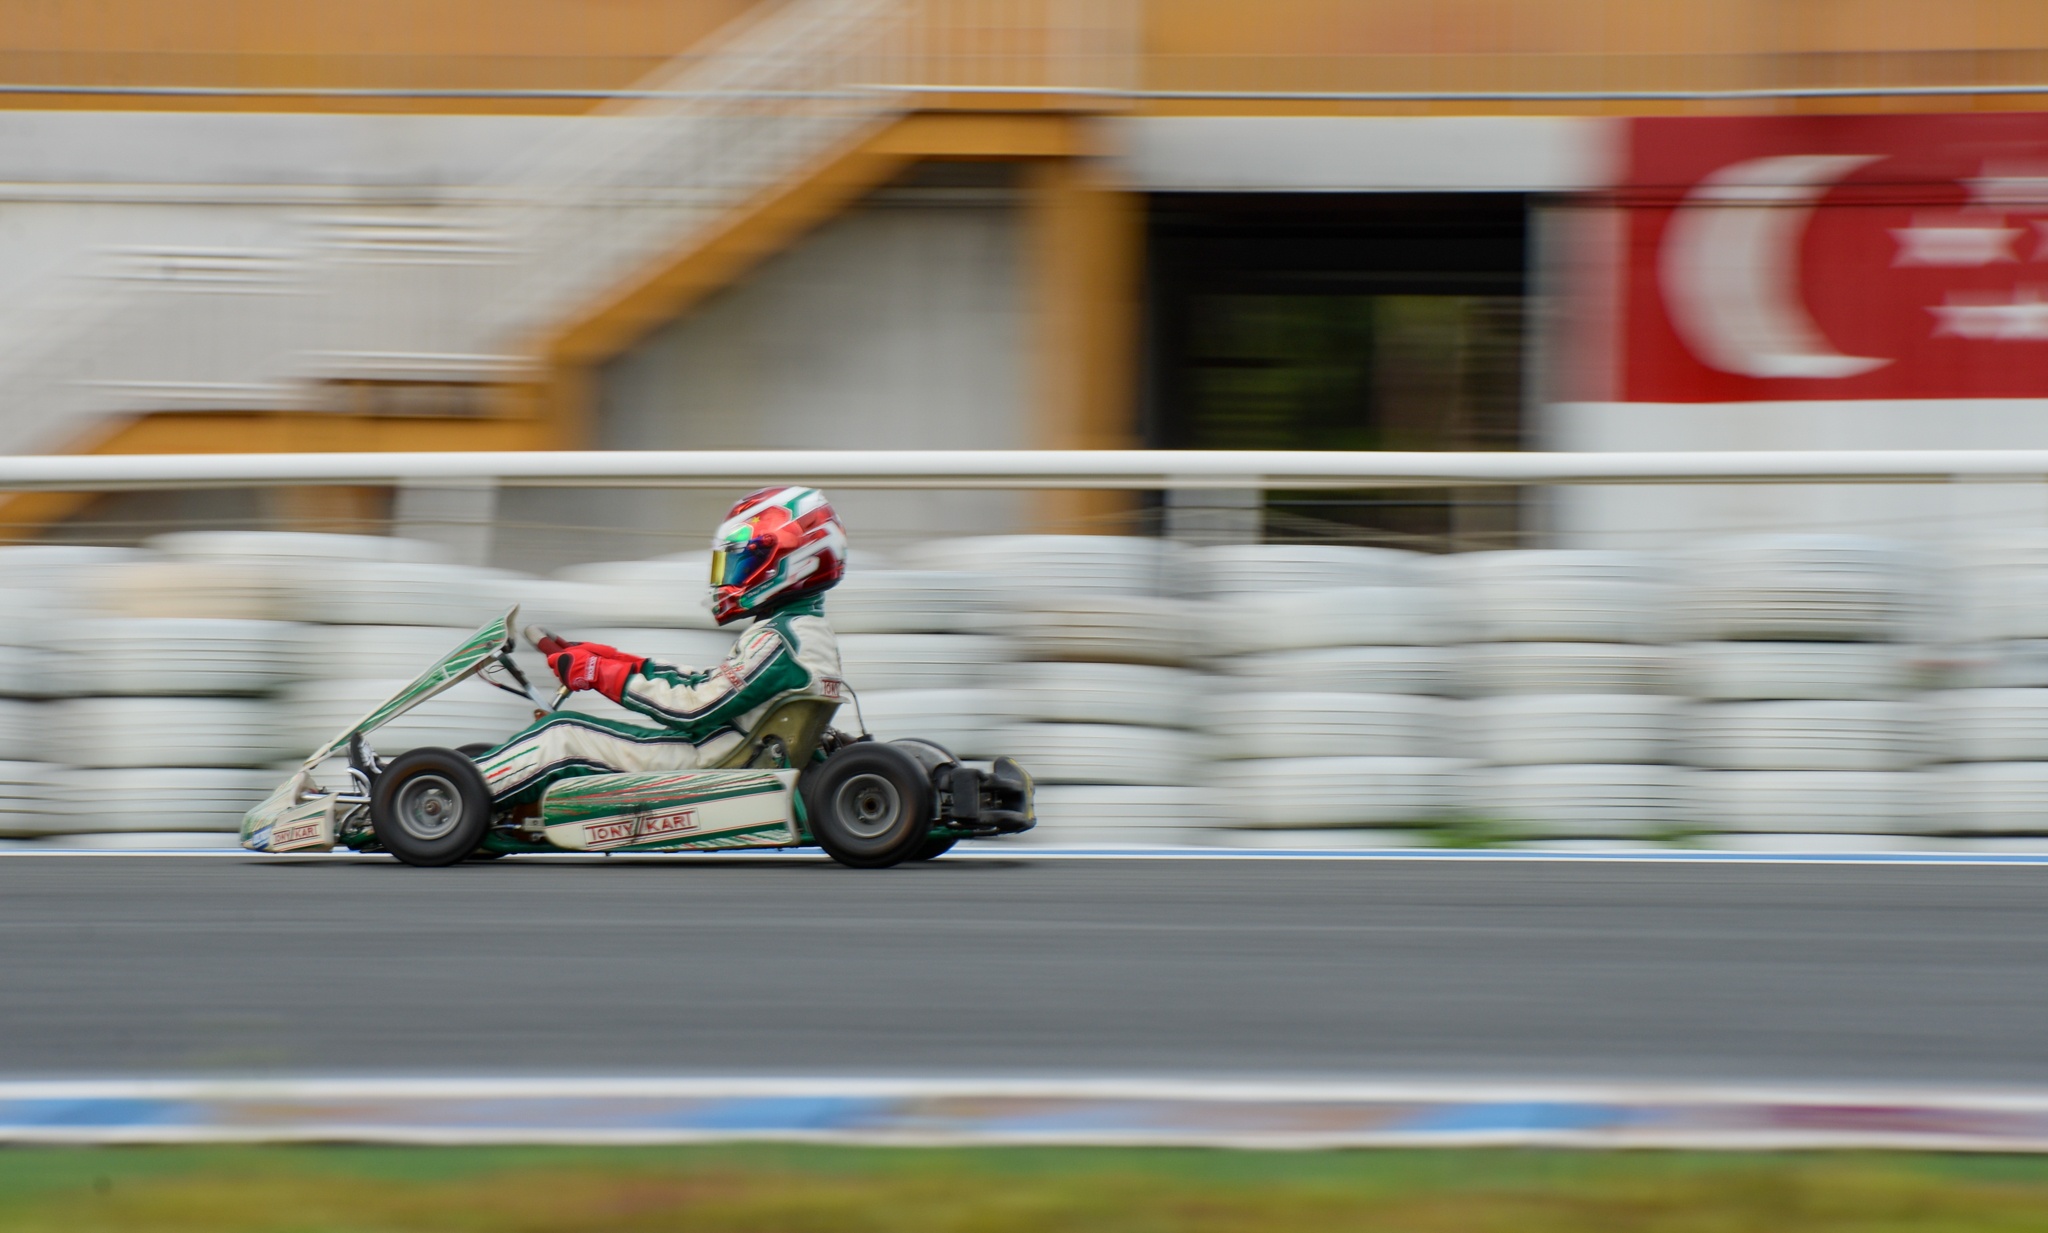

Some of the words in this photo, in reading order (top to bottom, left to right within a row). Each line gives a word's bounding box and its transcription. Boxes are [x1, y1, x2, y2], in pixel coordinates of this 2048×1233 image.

[295, 824, 319, 838] KART
[586, 821, 633, 841] TONY
[646, 810, 695, 832] KART
